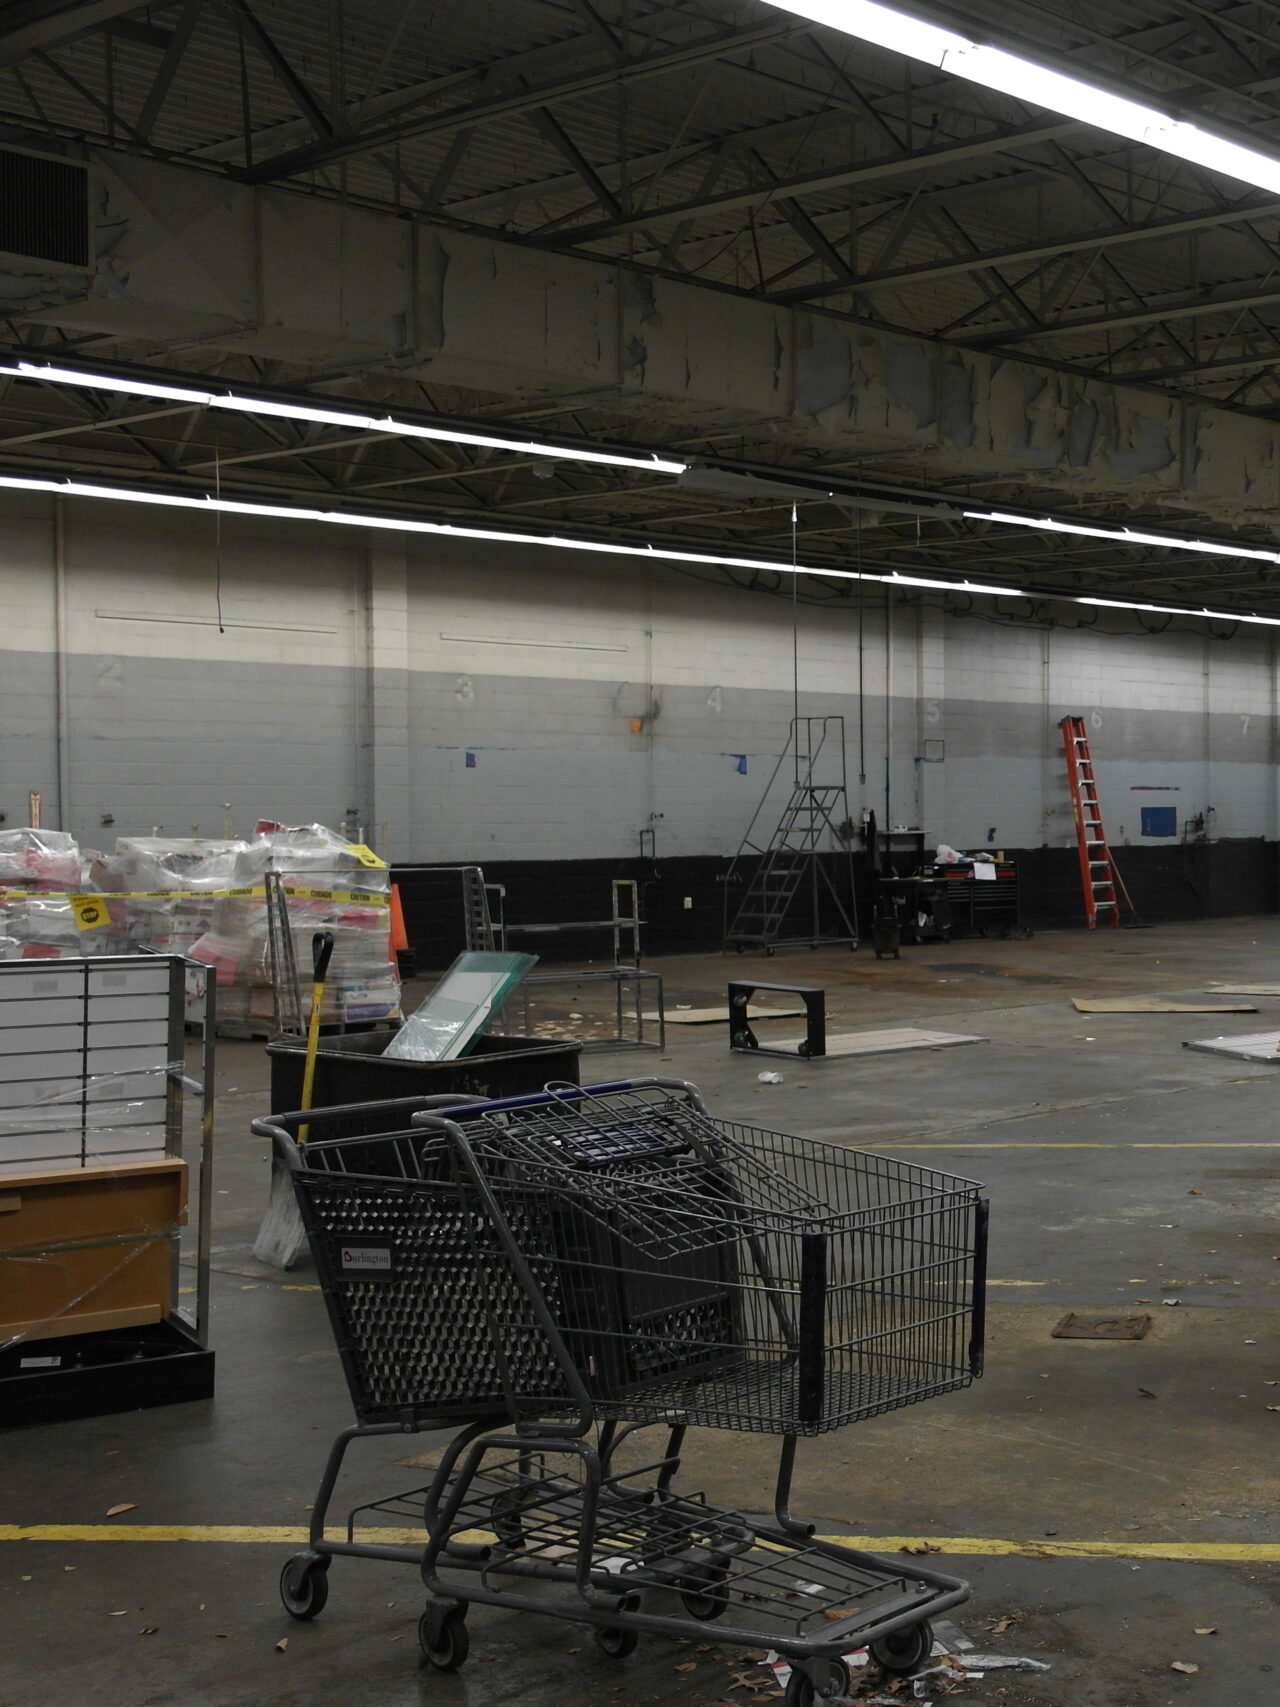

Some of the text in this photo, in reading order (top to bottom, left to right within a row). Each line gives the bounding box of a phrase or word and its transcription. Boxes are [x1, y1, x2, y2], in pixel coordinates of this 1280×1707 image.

[706, 687, 722, 713] 4
[927, 700, 940, 722] 5
[1091, 708, 1103, 728] 6
[1240, 715, 1250, 735] 7
[82, 911, 98, 920] STOP
[344, 1250, 389, 1264] Burlington
